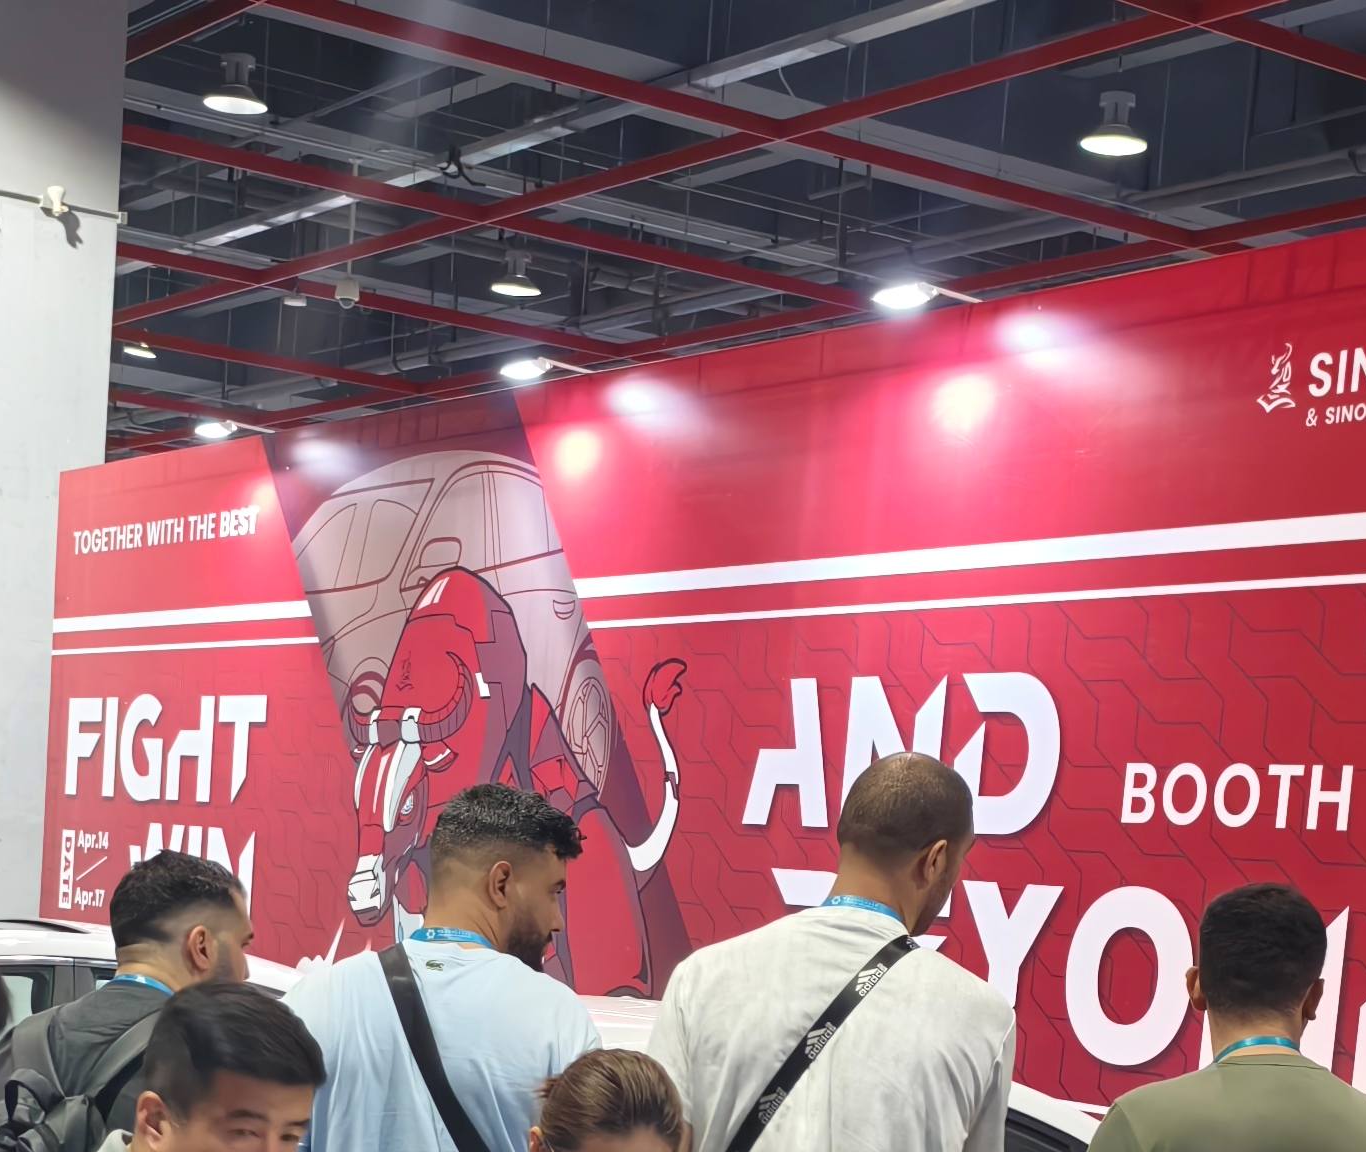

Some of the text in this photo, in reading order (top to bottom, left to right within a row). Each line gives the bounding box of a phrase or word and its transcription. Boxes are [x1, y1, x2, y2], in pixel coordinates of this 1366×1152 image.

[1305, 407, 1318, 427] &
[73, 505, 259, 556] TOGETHER WITH THE BEST
[64, 693, 268, 804] FIGHT
[1121, 762, 1353, 833] BOOTH
[77, 829, 109, 853] Apr.14
[61, 836, 73, 904] DATE
[74, 886, 105, 910] Apr.17
